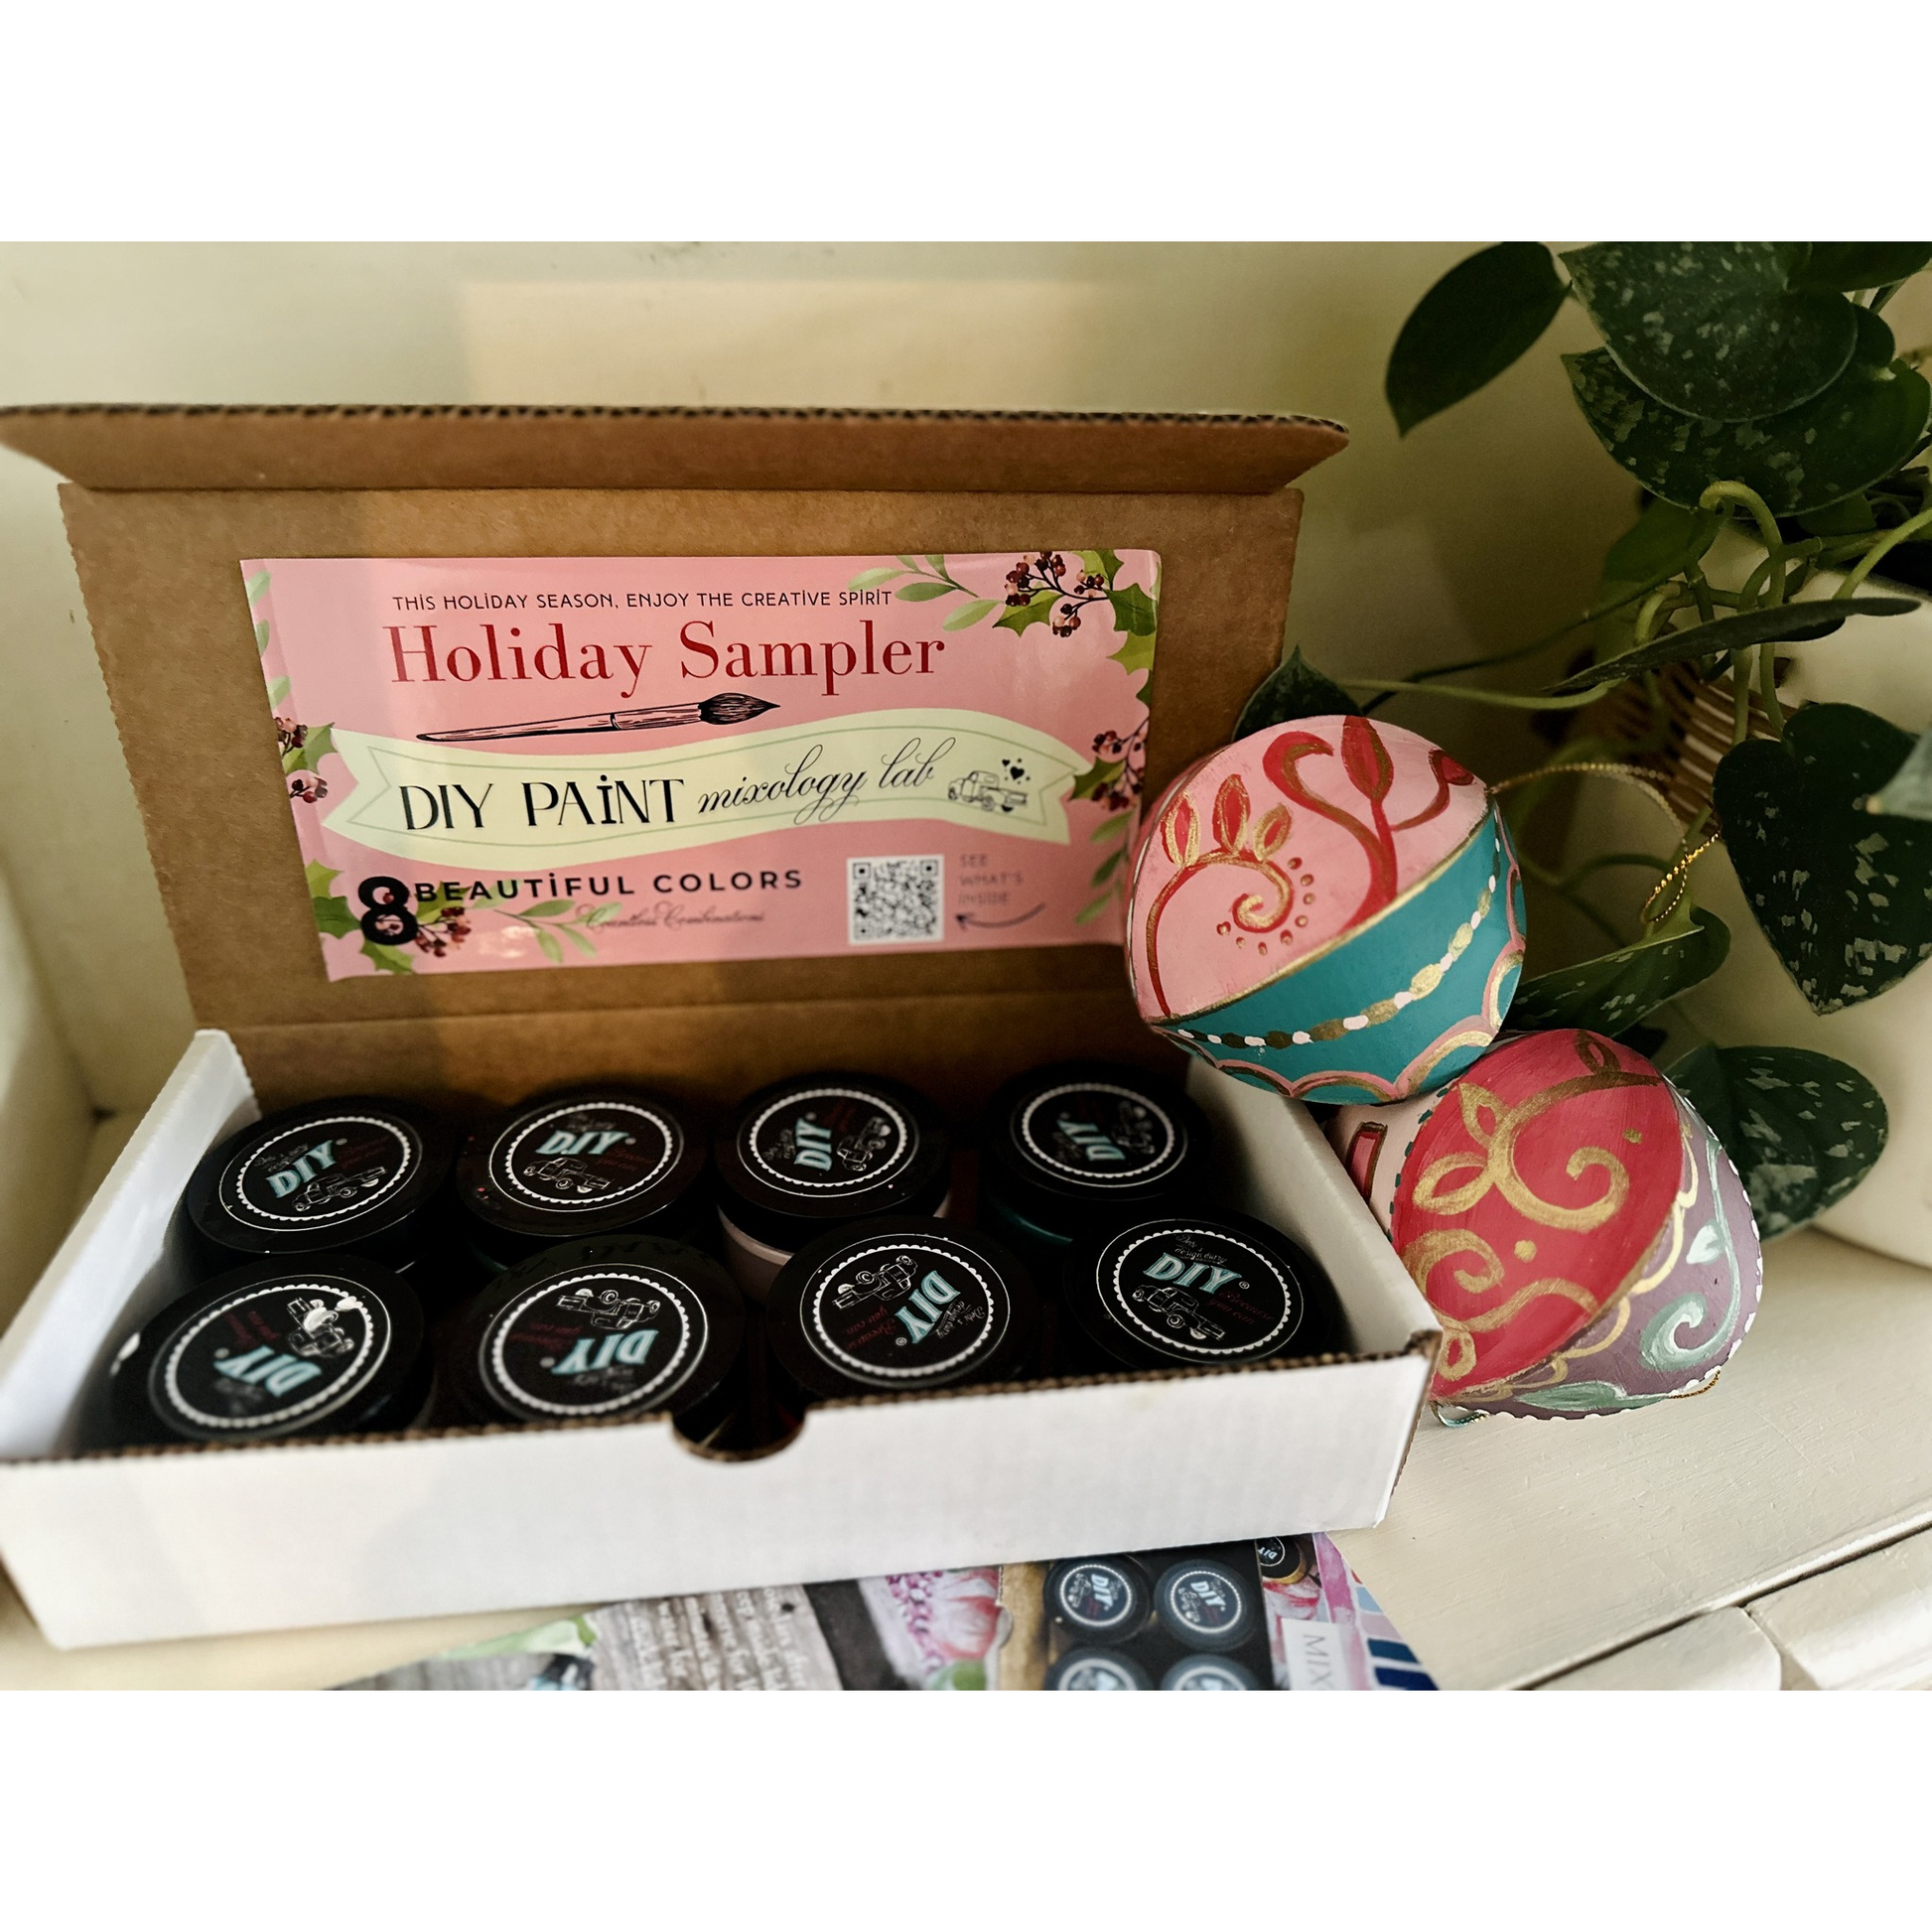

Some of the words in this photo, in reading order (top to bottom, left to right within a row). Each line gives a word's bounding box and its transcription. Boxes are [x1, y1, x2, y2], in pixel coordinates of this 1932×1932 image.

[537, 594, 619, 609] SEASON,
[627, 593, 689, 608] ENJOY
[696, 593, 734, 607] THE
[382, 622, 653, 698] Holiday
[679, 620, 945, 696] Sampler
[399, 782, 493, 830] DIY
[698, 744, 869, 825] mixology
[878, 737, 956, 788] lab
[357, 876, 418, 945] 8
[653, 870, 802, 894] COLORS
[535, 1130, 629, 1155] DIY
[794, 1117, 832, 1172] DIY
[1056, 1119, 1126, 1162] DIY
[265, 1140, 337, 1198] DIY
[1143, 1252, 1242, 1295] DIY
[895, 1270, 961, 1344] DIY
[212, 1345, 323, 1398] DIY
[550, 1328, 659, 1374] DIY
[1091, 1573, 1114, 1608] DIY
[1190, 1580, 1226, 1608] DIY
